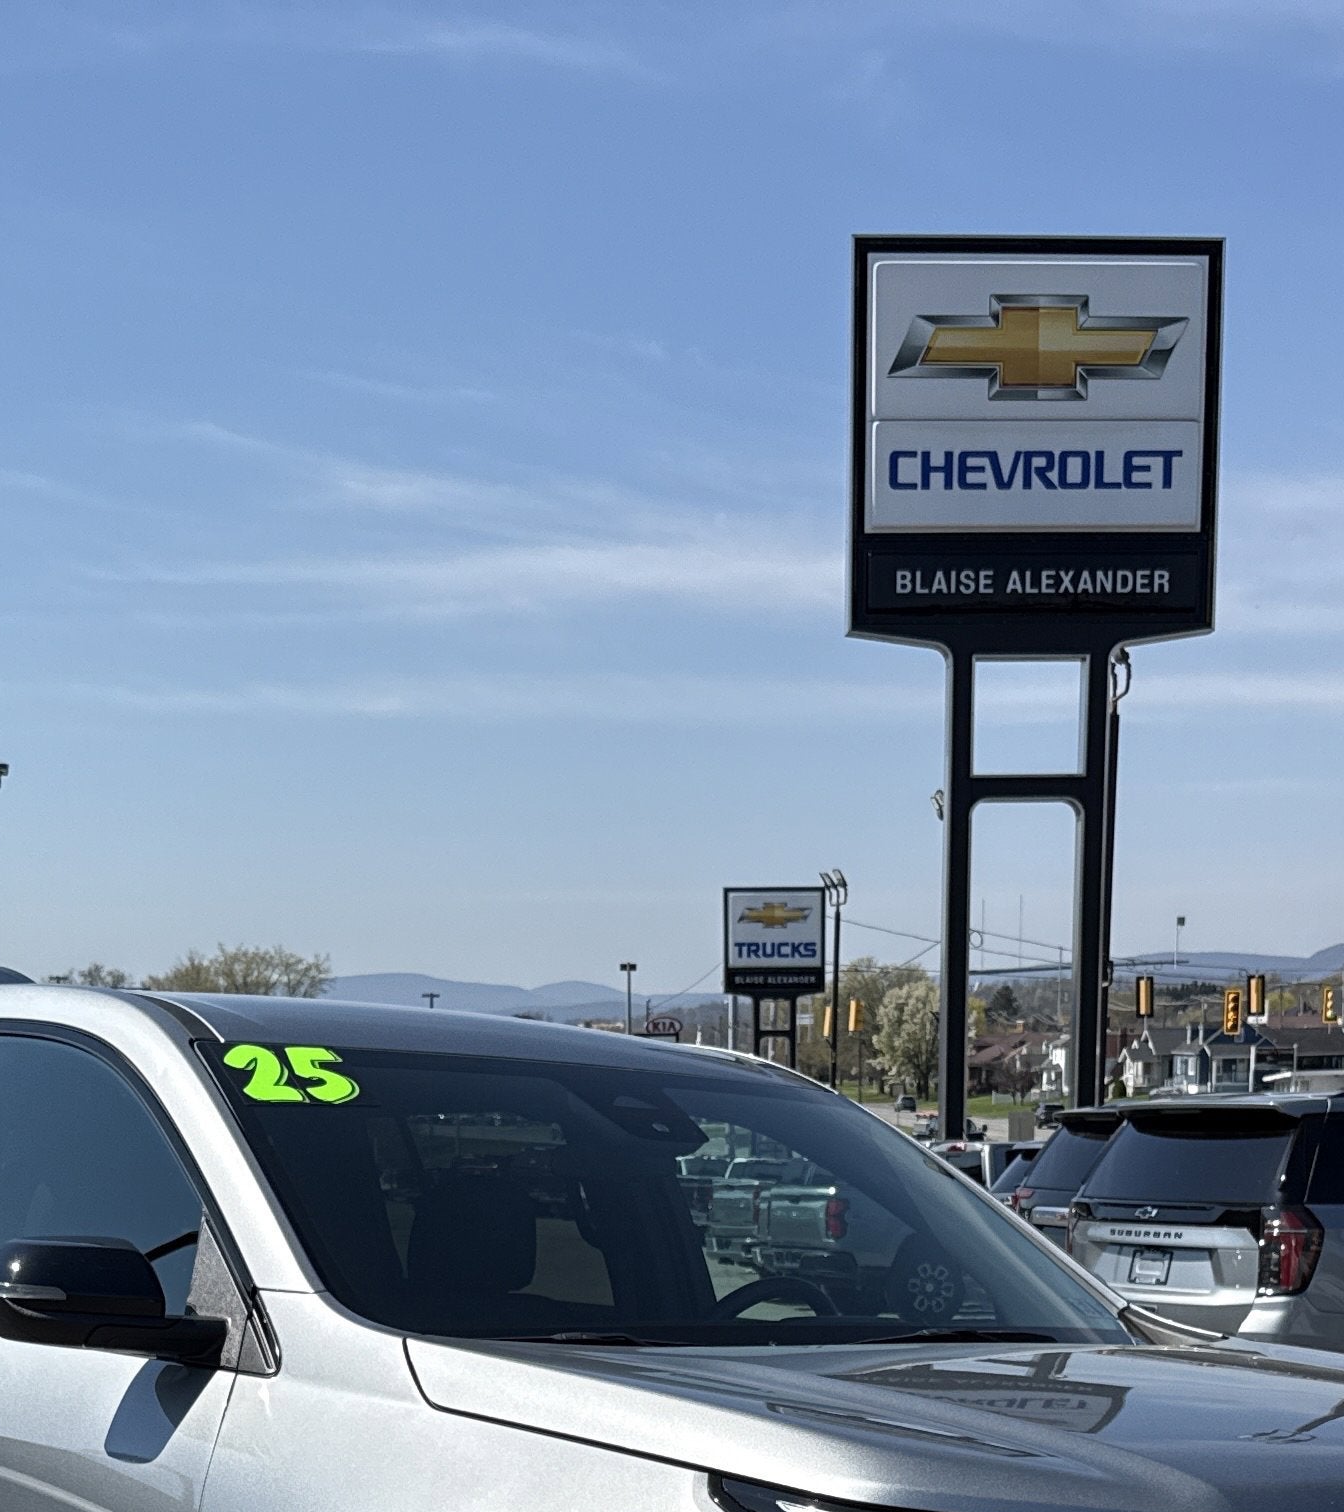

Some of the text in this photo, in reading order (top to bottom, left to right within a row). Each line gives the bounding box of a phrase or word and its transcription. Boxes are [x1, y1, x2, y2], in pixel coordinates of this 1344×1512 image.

[888, 449, 1184, 491] CHEVROLET
[895, 569, 1171, 595] BLAISE ALEXANDER
[734, 942, 818, 959] TRUCKS
[734, 975, 817, 985] BLAISE ALEXANDER
[652, 1021, 677, 1033] KIA
[223, 1044, 360, 1105] 25
[1109, 1228, 1184, 1240] SUBURBAN
